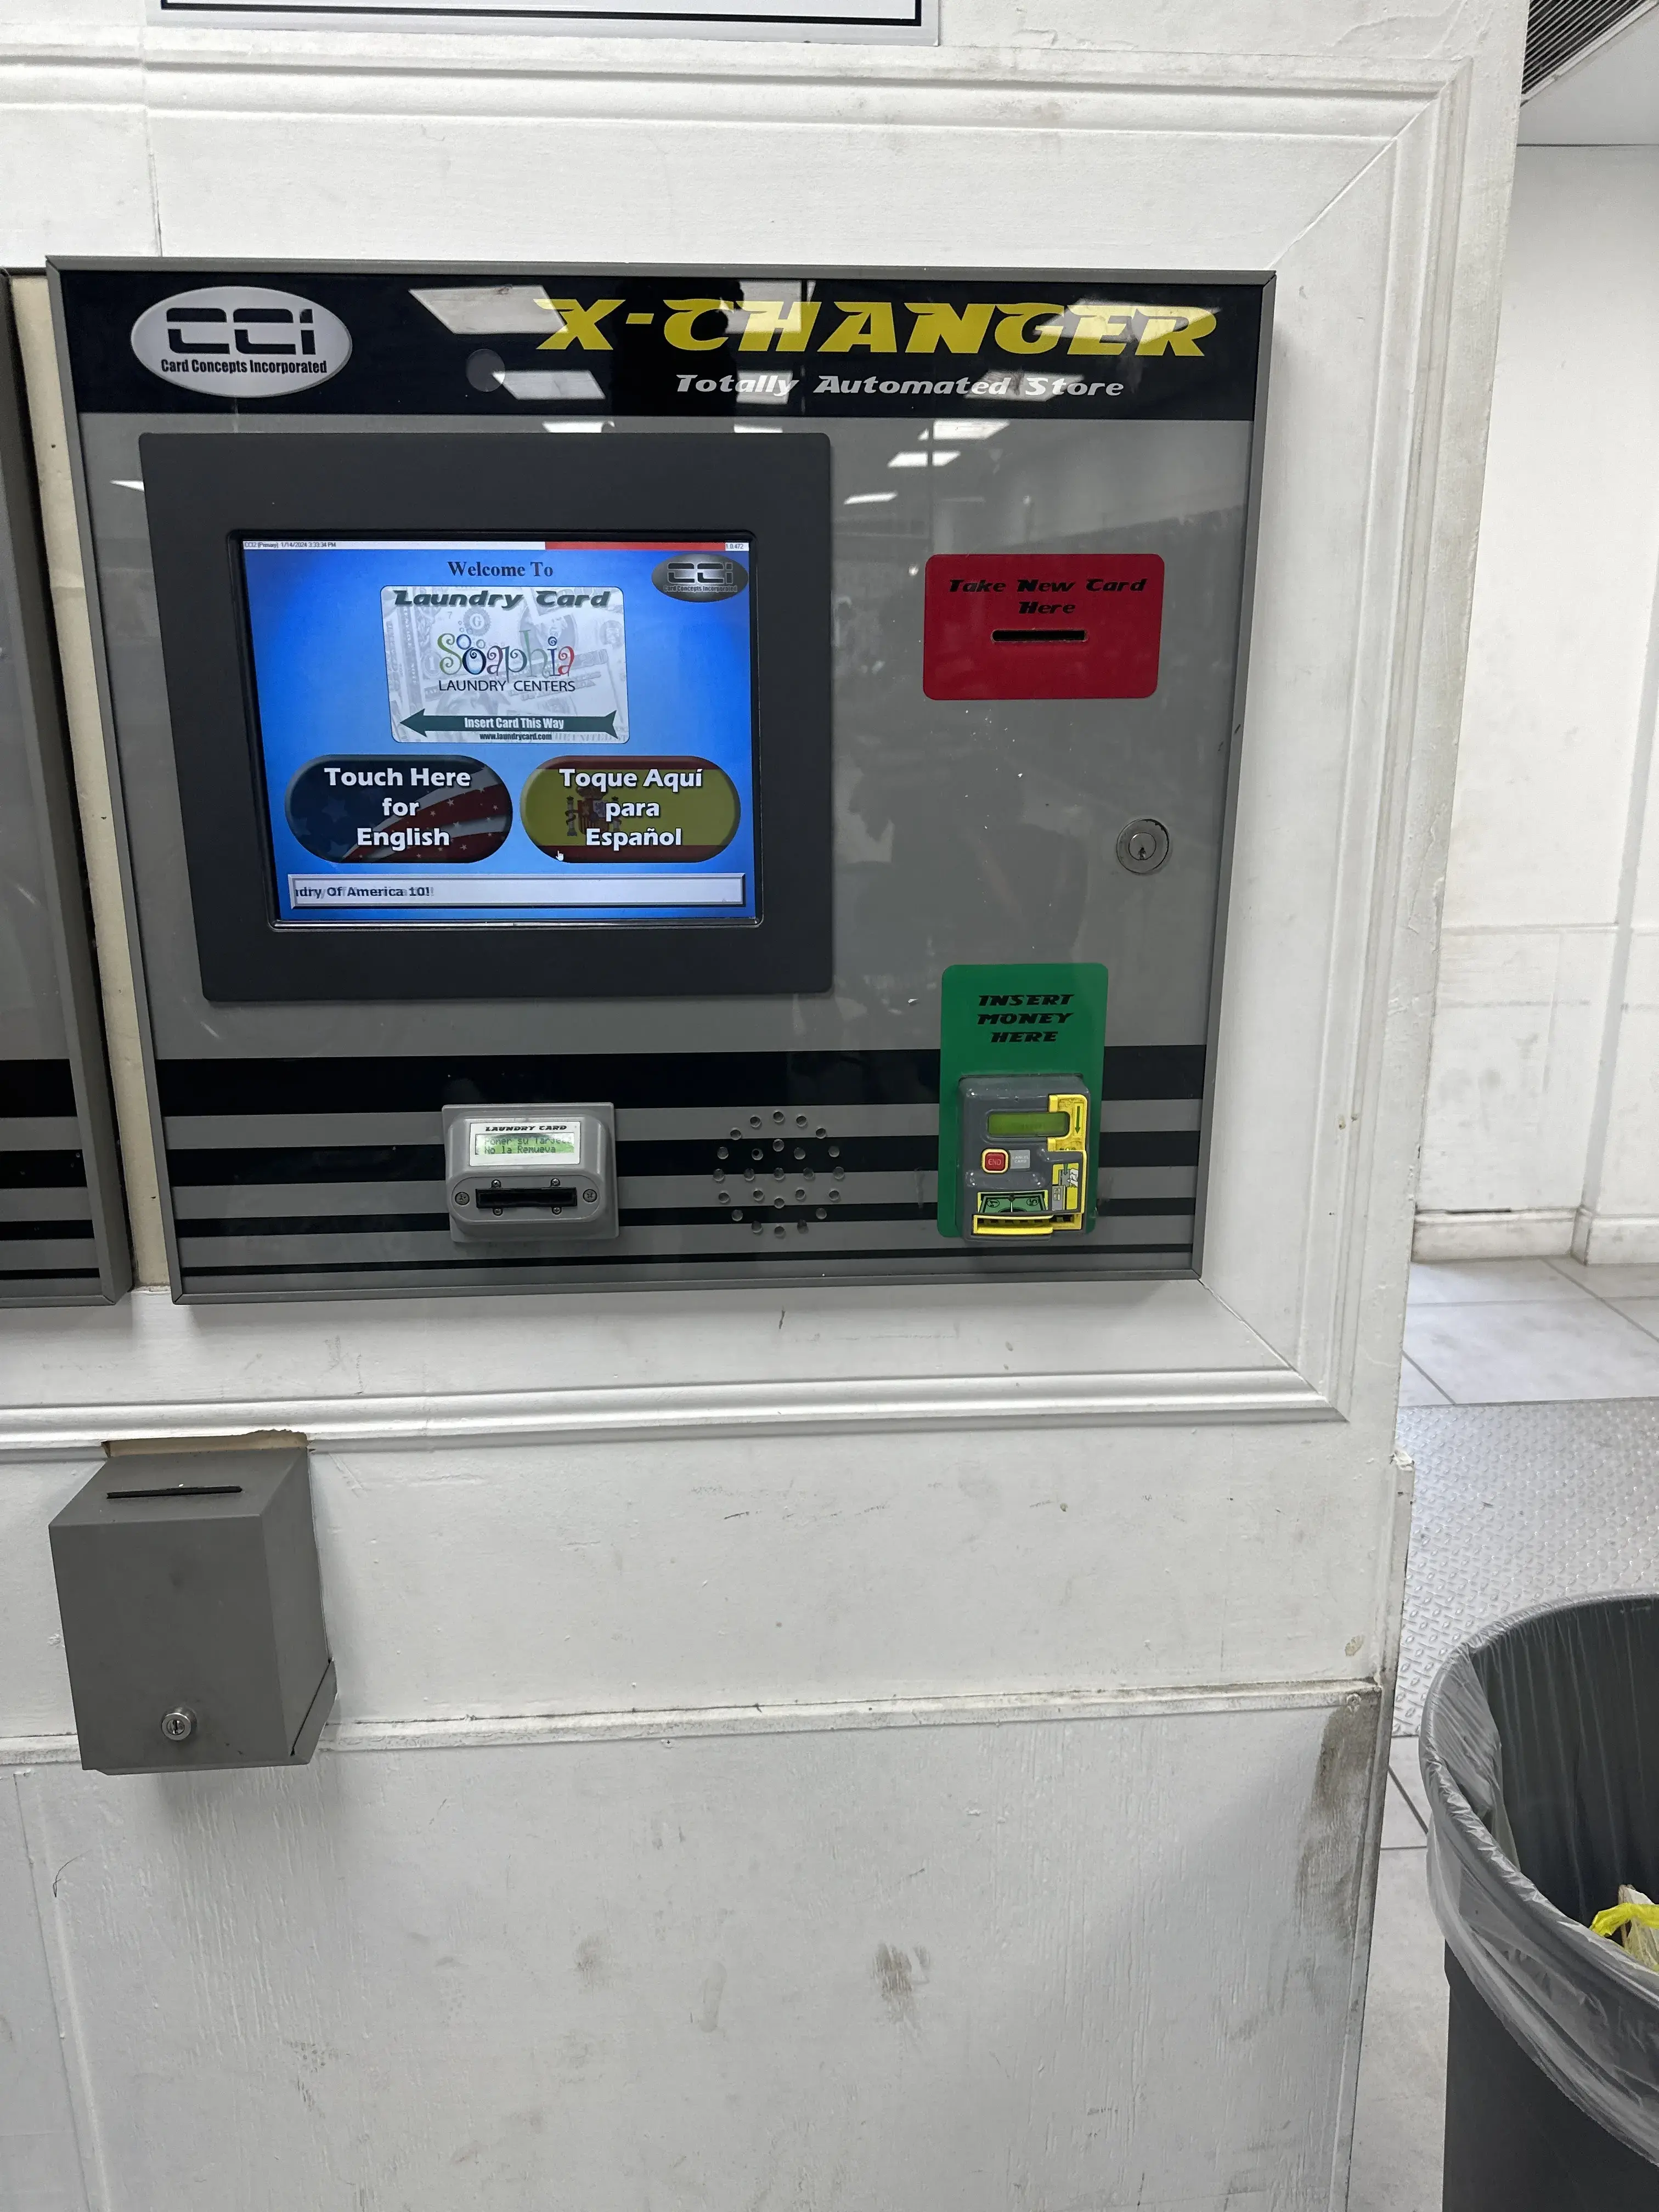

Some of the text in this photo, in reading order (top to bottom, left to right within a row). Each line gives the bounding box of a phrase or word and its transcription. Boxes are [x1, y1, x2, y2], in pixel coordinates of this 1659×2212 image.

[533, 298, 1217, 357] X-CHANGER
[161, 359, 328, 374] Card Concepts Incorporated
[675, 374, 1125, 397] Totally Automated Store
[447, 561, 553, 577] Welcome To
[949, 578, 1148, 592] Take New Card
[393, 590, 611, 610] Laundry Card
[1018, 601, 1076, 614] Here
[438, 680, 575, 692] LAUNDRY CENTERS
[464, 717, 565, 730] Insert Card This Way
[479, 732, 552, 741] www.laundrycard.com
[324, 768, 472, 787] Touch Here
[558, 768, 704, 793] Toque Aquí
[382, 798, 420, 817] for
[605, 803, 661, 821] para
[357, 827, 450, 850] English
[585, 828, 682, 851] Español
[327, 887, 343, 897] Of
[347, 887, 404, 897] America
[978, 994, 1075, 1007] INSERT
[977, 1012, 1075, 1025] MONEY
[990, 1031, 1059, 1043] HERE
[484, 1146, 556, 1154] No la Remueva
